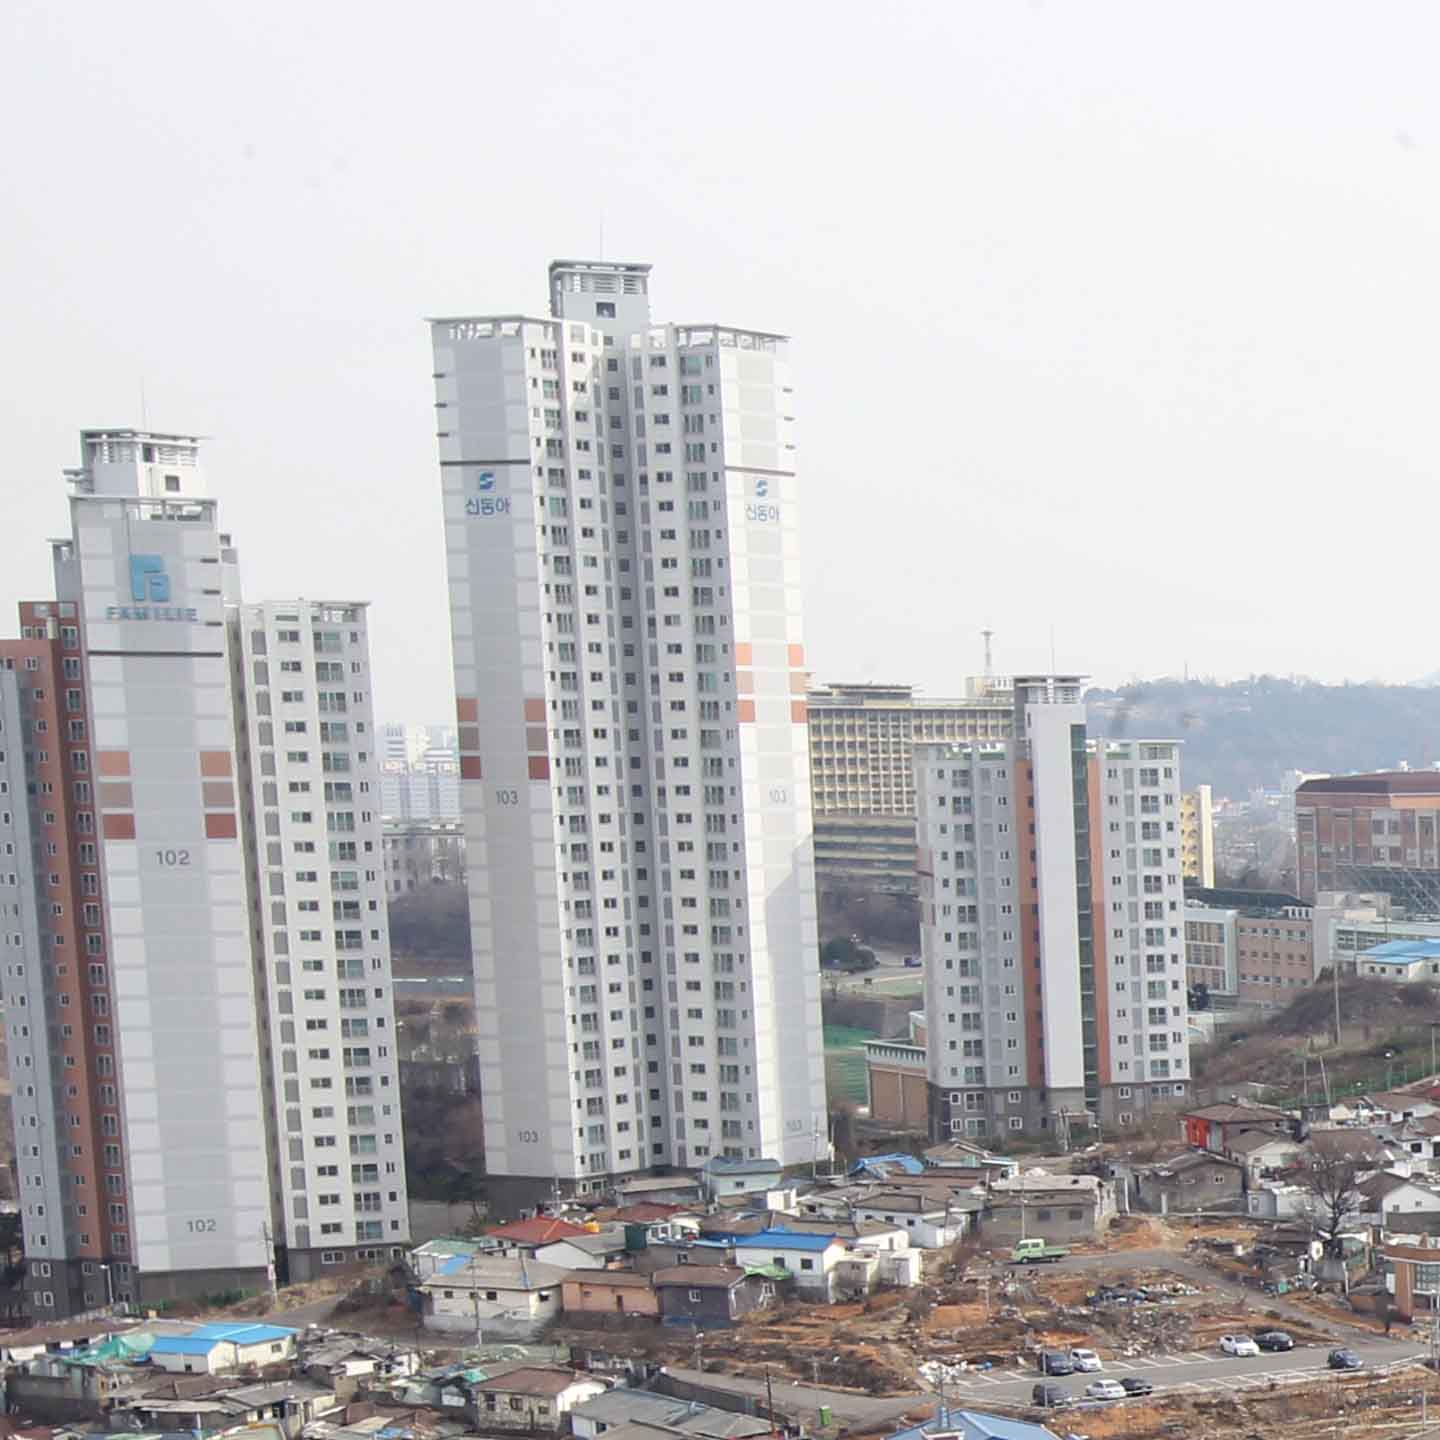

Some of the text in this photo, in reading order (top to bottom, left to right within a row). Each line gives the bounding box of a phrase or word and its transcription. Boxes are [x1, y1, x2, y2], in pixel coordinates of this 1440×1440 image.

[465, 497, 511, 517] 신동아
[744, 504, 781, 522] 신동아
[495, 790, 519, 805] 103
[156, 850, 190, 865] 102
[517, 1131, 539, 1143] 103
[186, 1219, 217, 1232] 102
